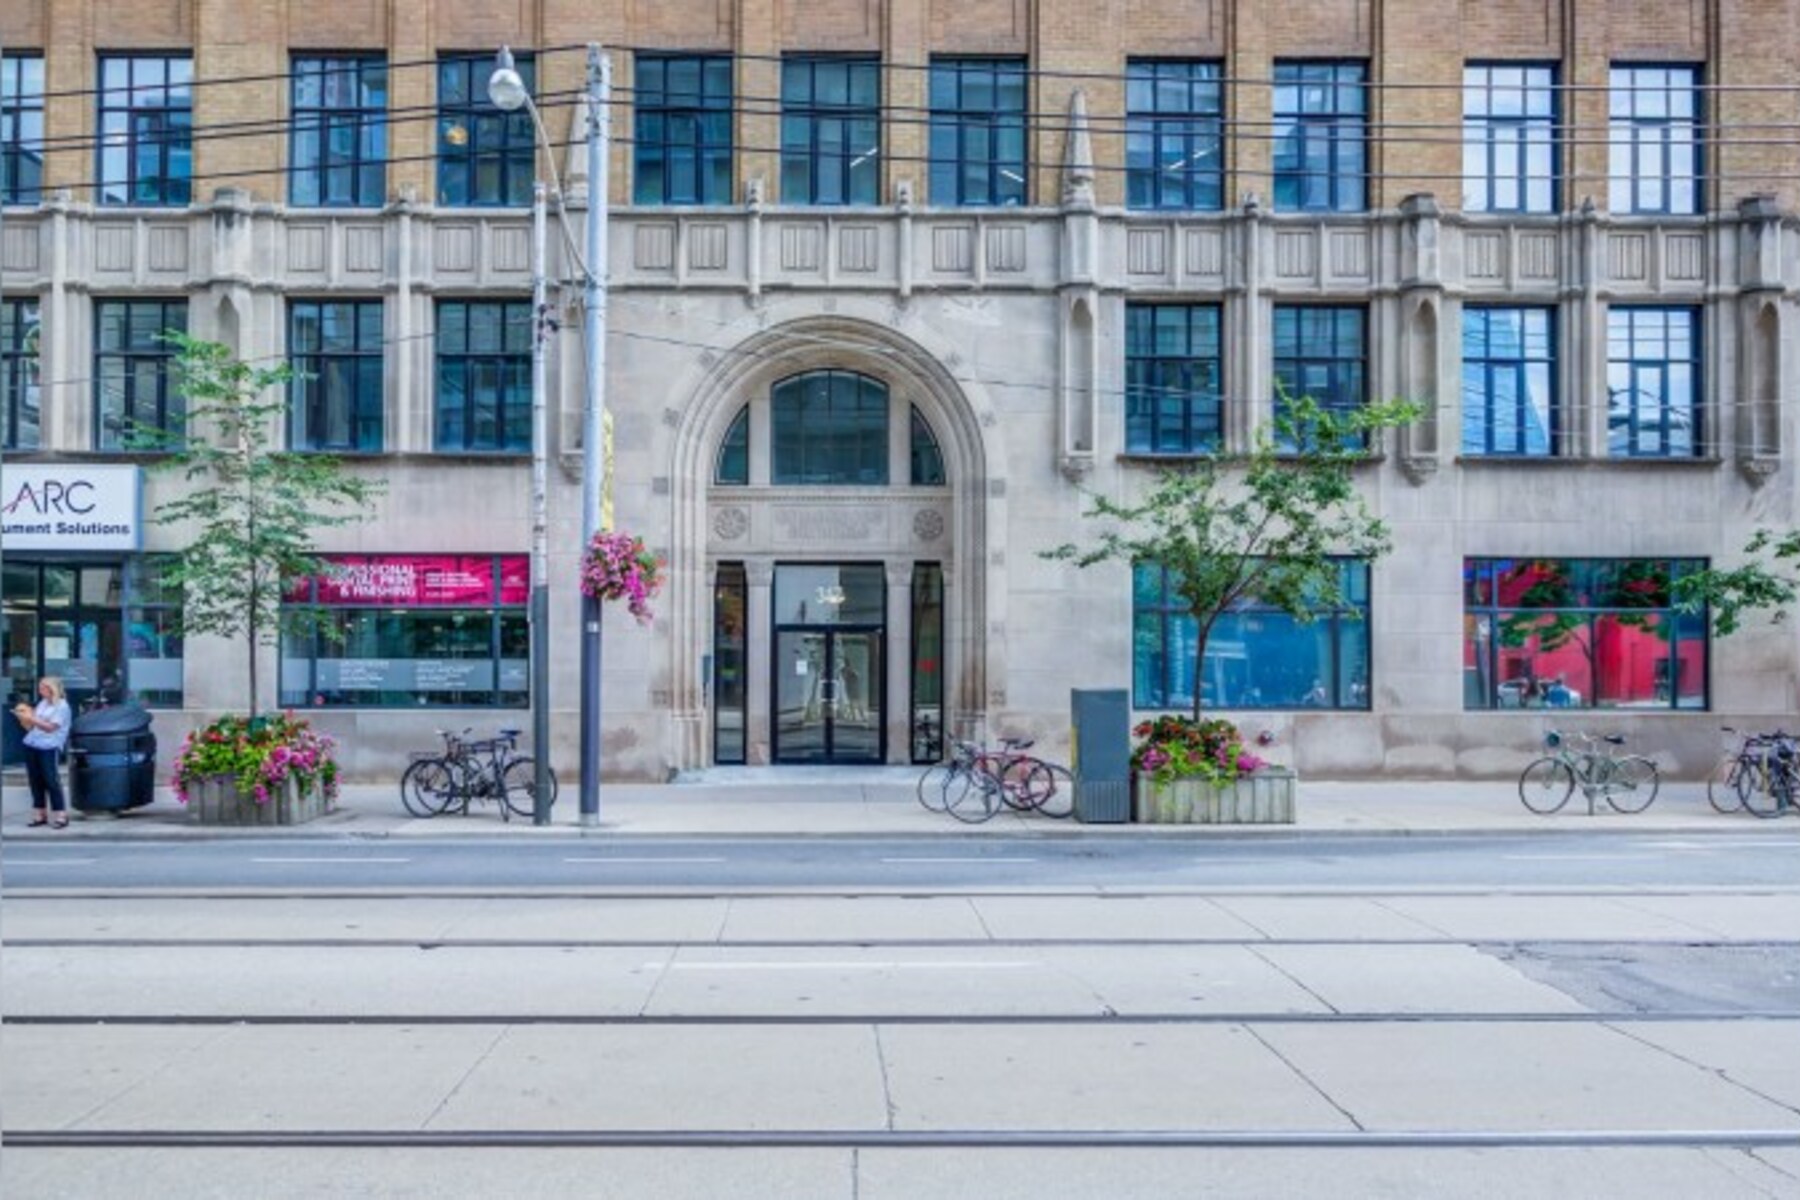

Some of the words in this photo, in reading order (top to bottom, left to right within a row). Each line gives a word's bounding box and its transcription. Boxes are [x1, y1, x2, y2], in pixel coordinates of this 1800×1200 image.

[7, 480, 95, 513] ARC
[56, 521, 130, 536] Solutions
[353, 585, 416, 597] FINISHING
